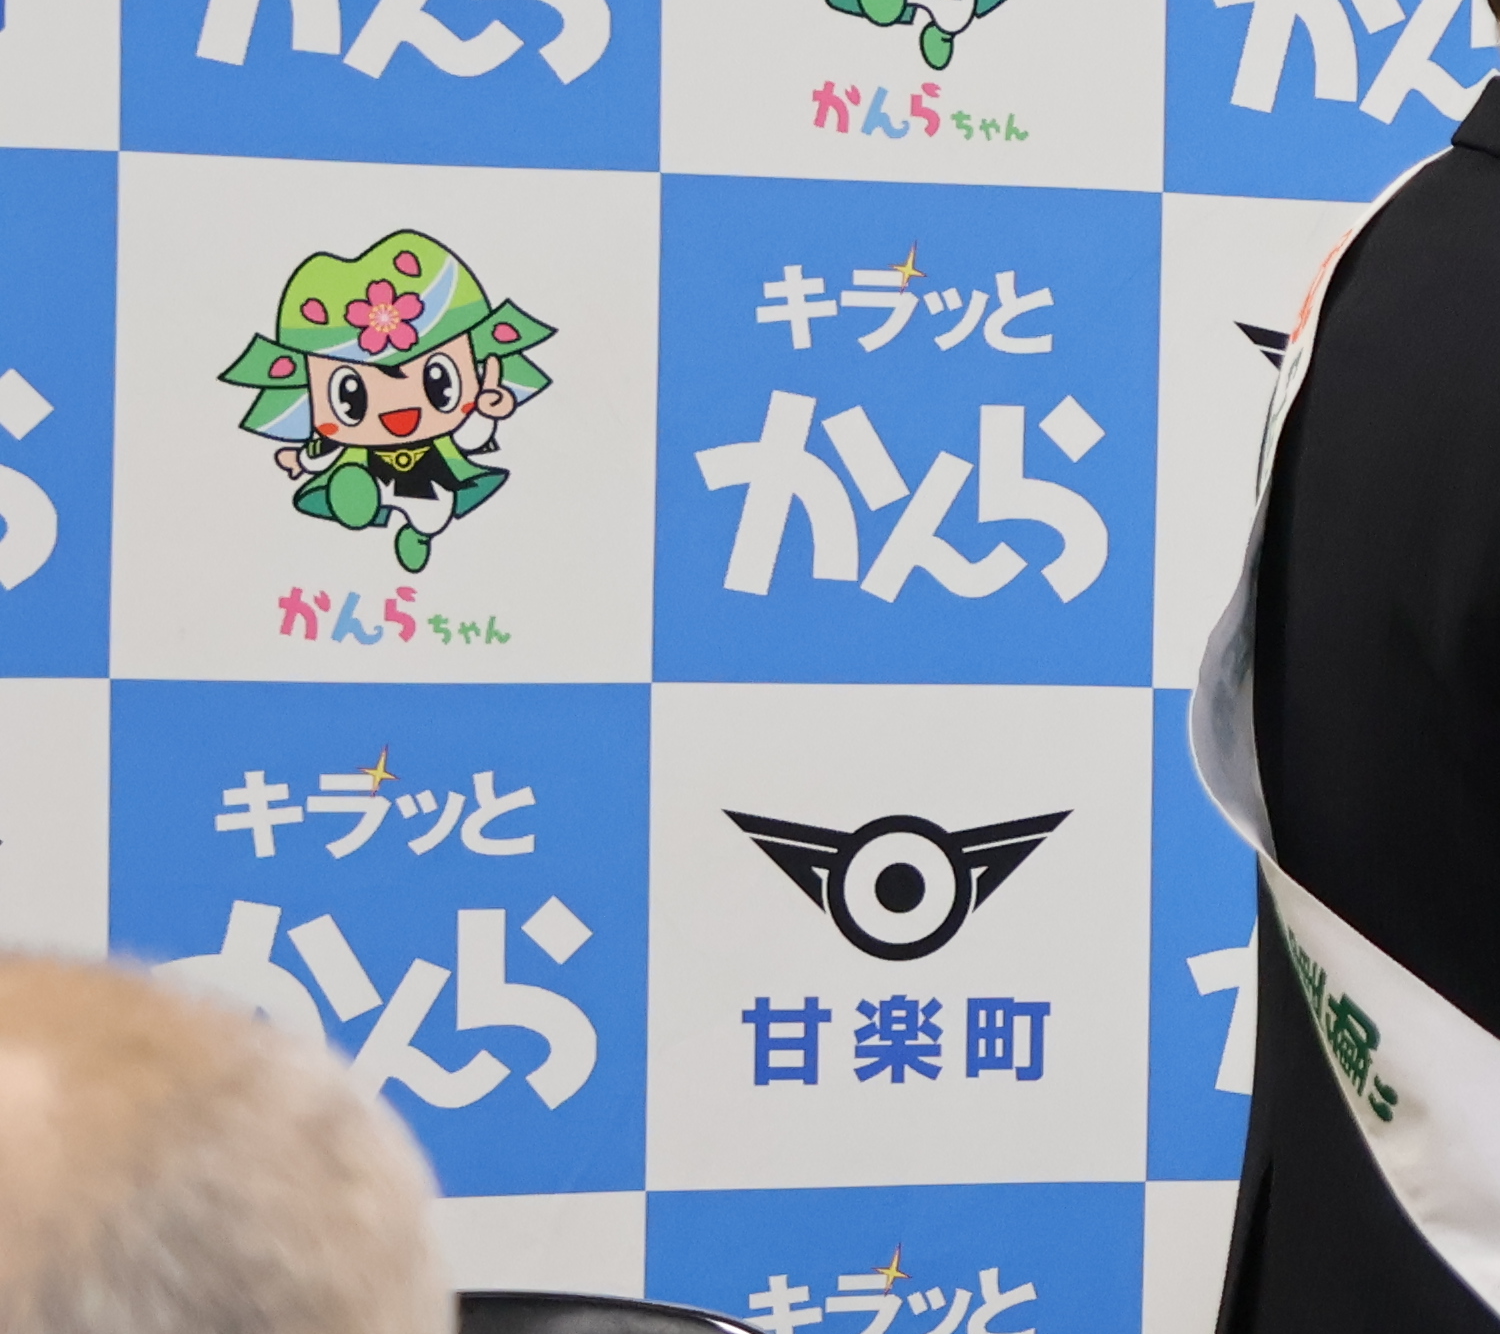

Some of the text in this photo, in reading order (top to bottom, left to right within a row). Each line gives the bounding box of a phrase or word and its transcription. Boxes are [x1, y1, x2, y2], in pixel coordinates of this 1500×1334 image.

[813, 81, 1026, 139] かんらちゃん
[757, 265, 1053, 353] キラッと
[695, 391, 1108, 602] かんら
[279, 587, 508, 644] かんらちゃん
[216, 769, 535, 858] キラッと
[743, 995, 1050, 1085] 甘楽町
